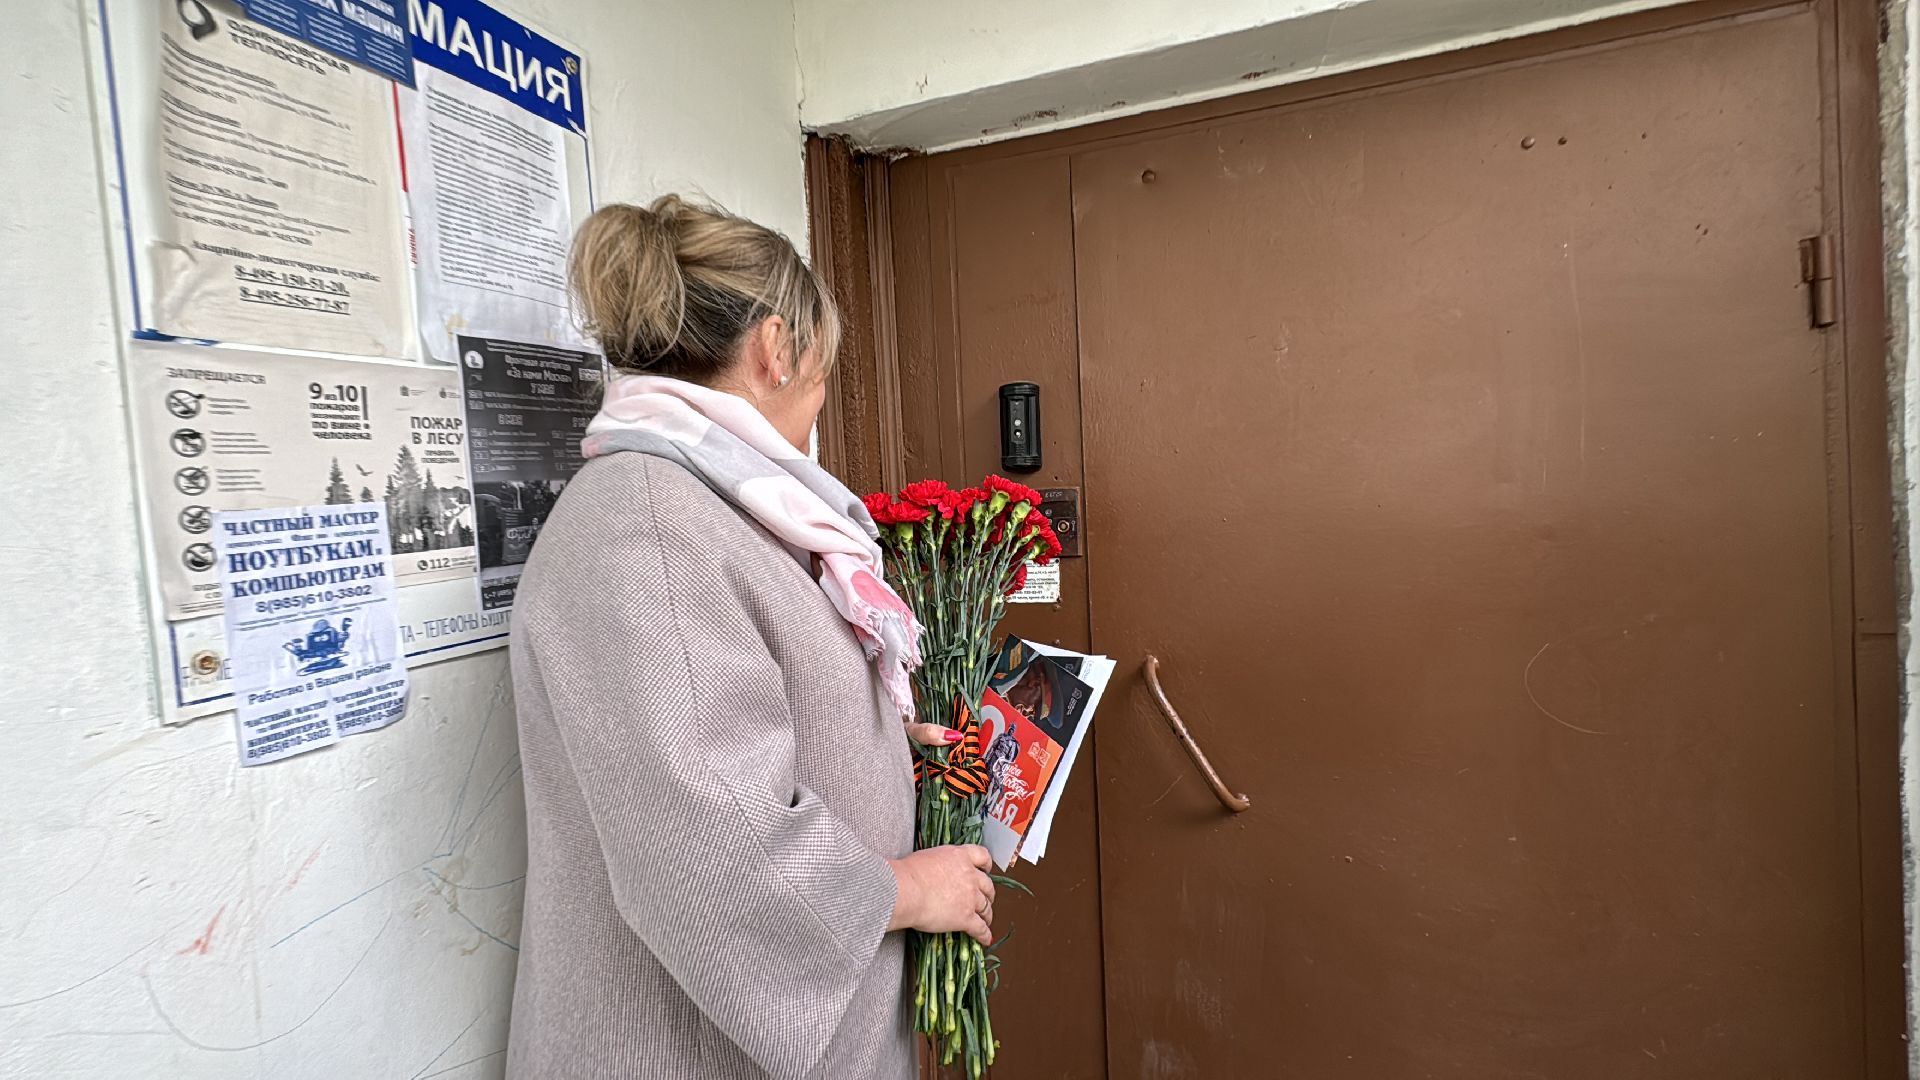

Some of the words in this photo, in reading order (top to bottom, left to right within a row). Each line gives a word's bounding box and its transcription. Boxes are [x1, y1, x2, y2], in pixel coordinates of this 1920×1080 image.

[228, 31, 327, 76] ТЕПЛОСЕТЬ
[165, 367, 267, 385] ЗАПРЕЩАЕТСЯ
[309, 382, 322, 400] 9
[335, 384, 359, 402] 10
[309, 402, 361, 413] пожаров
[311, 421, 328, 430] по
[331, 421, 361, 430] вине
[410, 416, 464, 430] ПОЖАР
[312, 431, 373, 441] человека
[411, 432, 422, 445] В
[426, 432, 465, 446] ЛЕСУ
[222, 512, 314, 536] ЧАСТНЫЙ
[319, 511, 380, 529] МАСТЕР
[429, 557, 451, 570] 112
[230, 562, 387, 598] КОМПЬЮТЕРАМ
[255, 584, 373, 614] 8(985)610-3802
[423, 612, 479, 638] ТЕЛЕФОНЫ
[247, 690, 305, 705] Работаю
[306, 682, 315, 691] в
[315, 672, 354, 688] Вашем
[355, 662, 393, 681] районе
